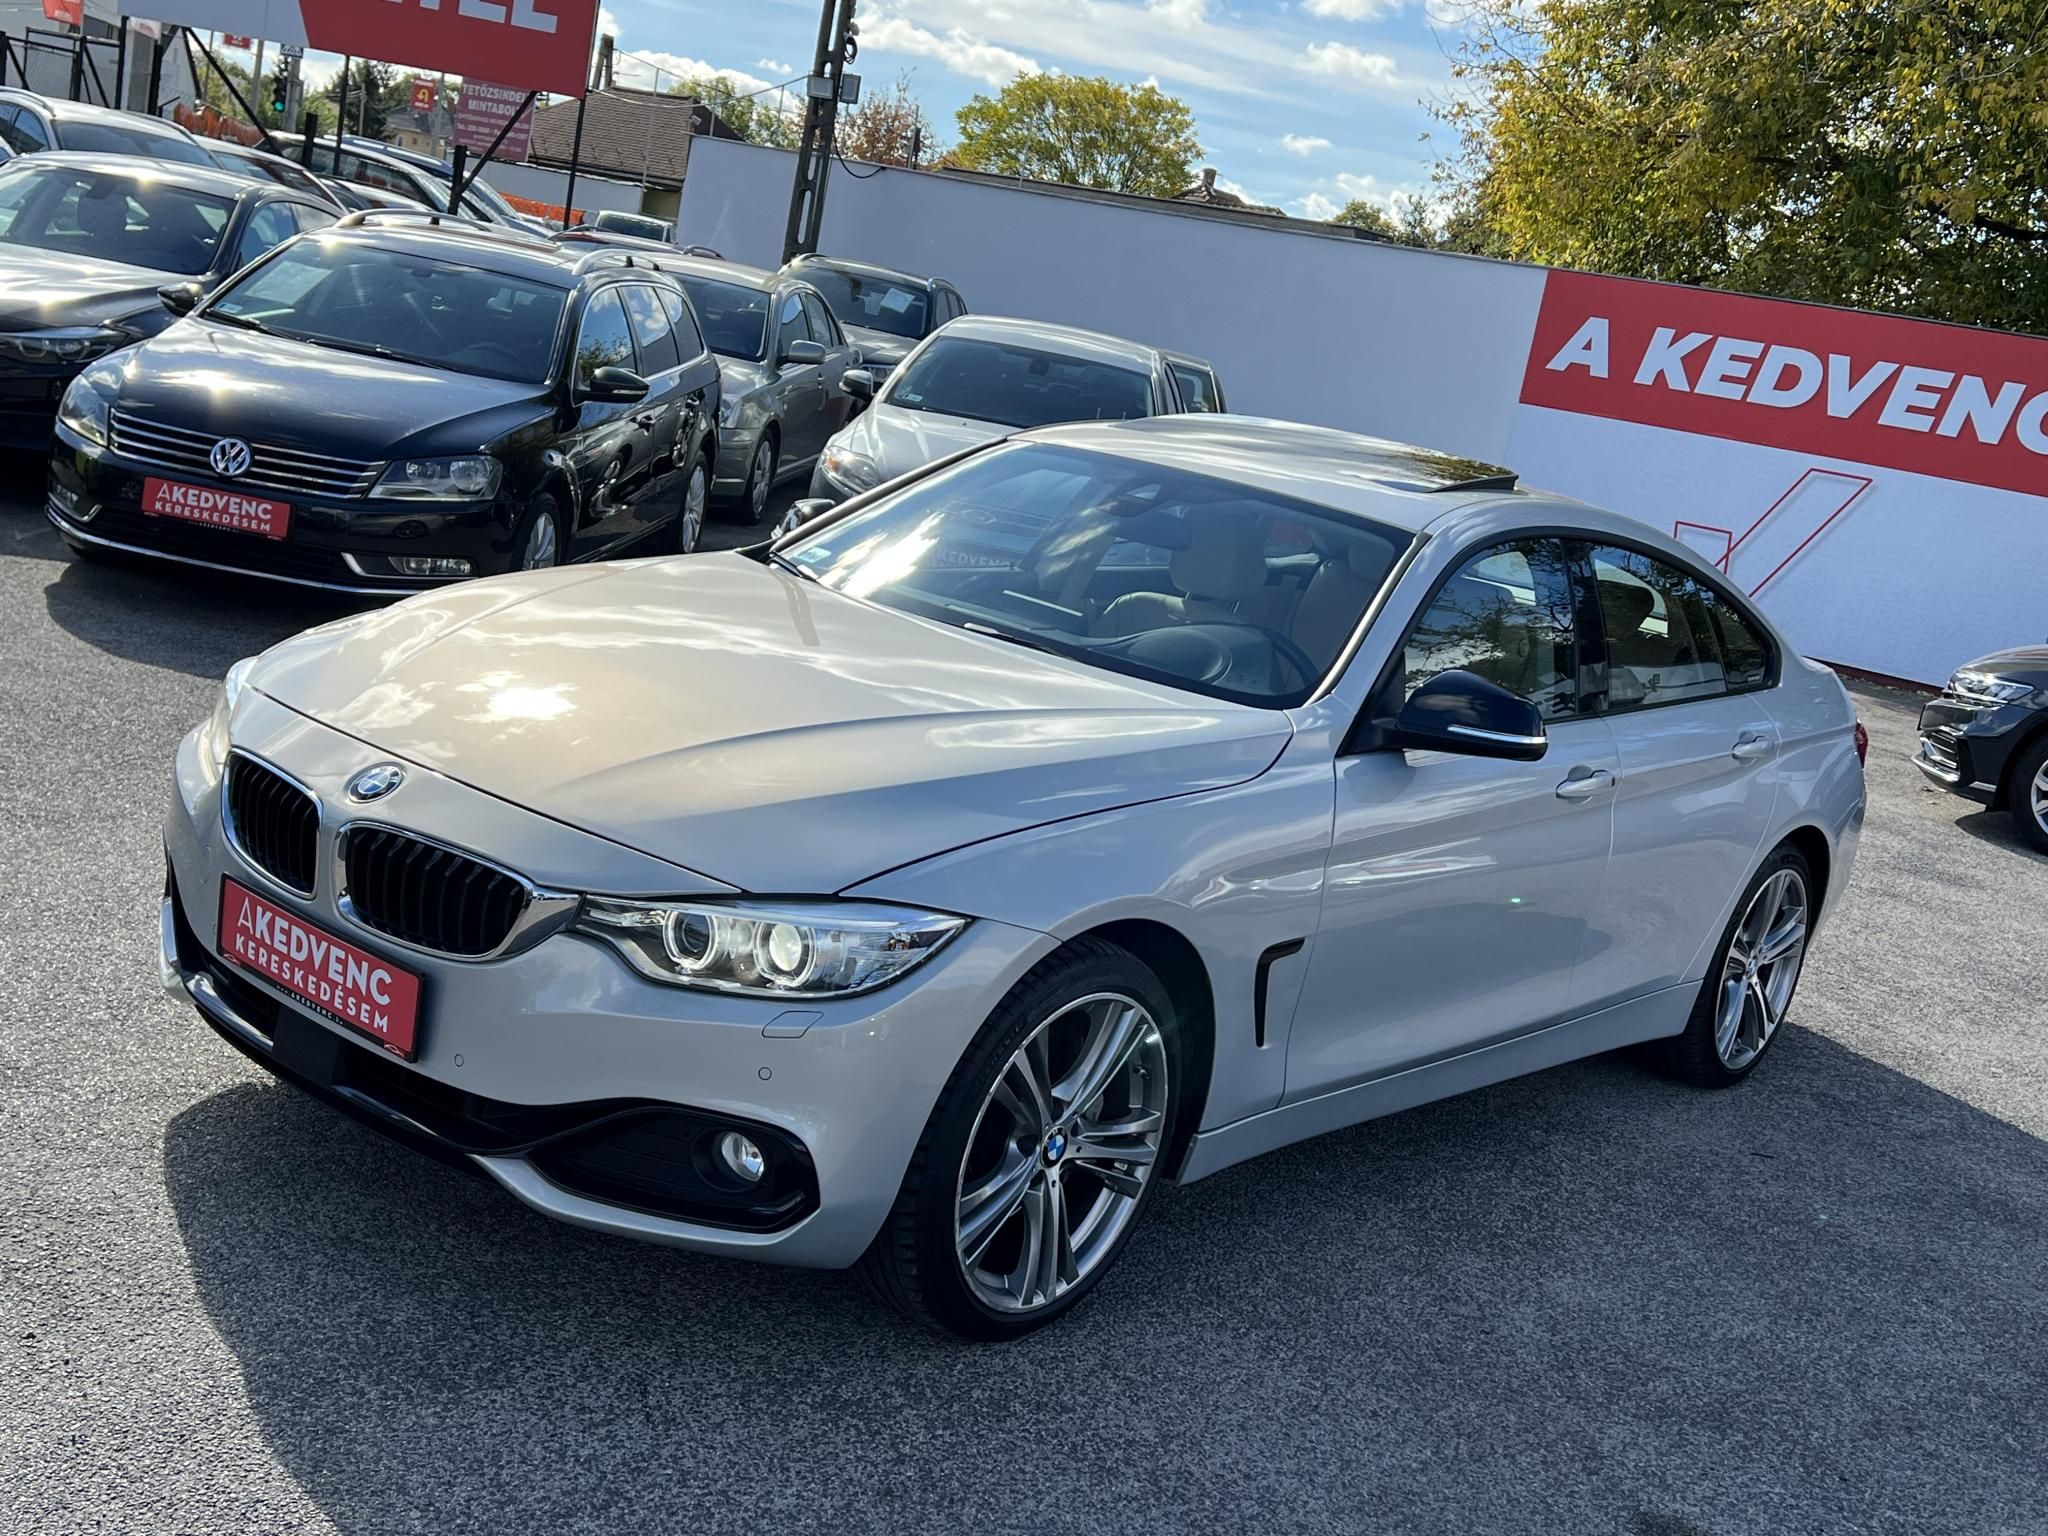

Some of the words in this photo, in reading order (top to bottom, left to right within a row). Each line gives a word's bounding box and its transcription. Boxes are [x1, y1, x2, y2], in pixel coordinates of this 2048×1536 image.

[1545, 316, 1609, 378] A
[155, 501, 271, 532] KERESKEDÉSEM
[235, 933, 389, 1033] KERESKEDÉSEM
